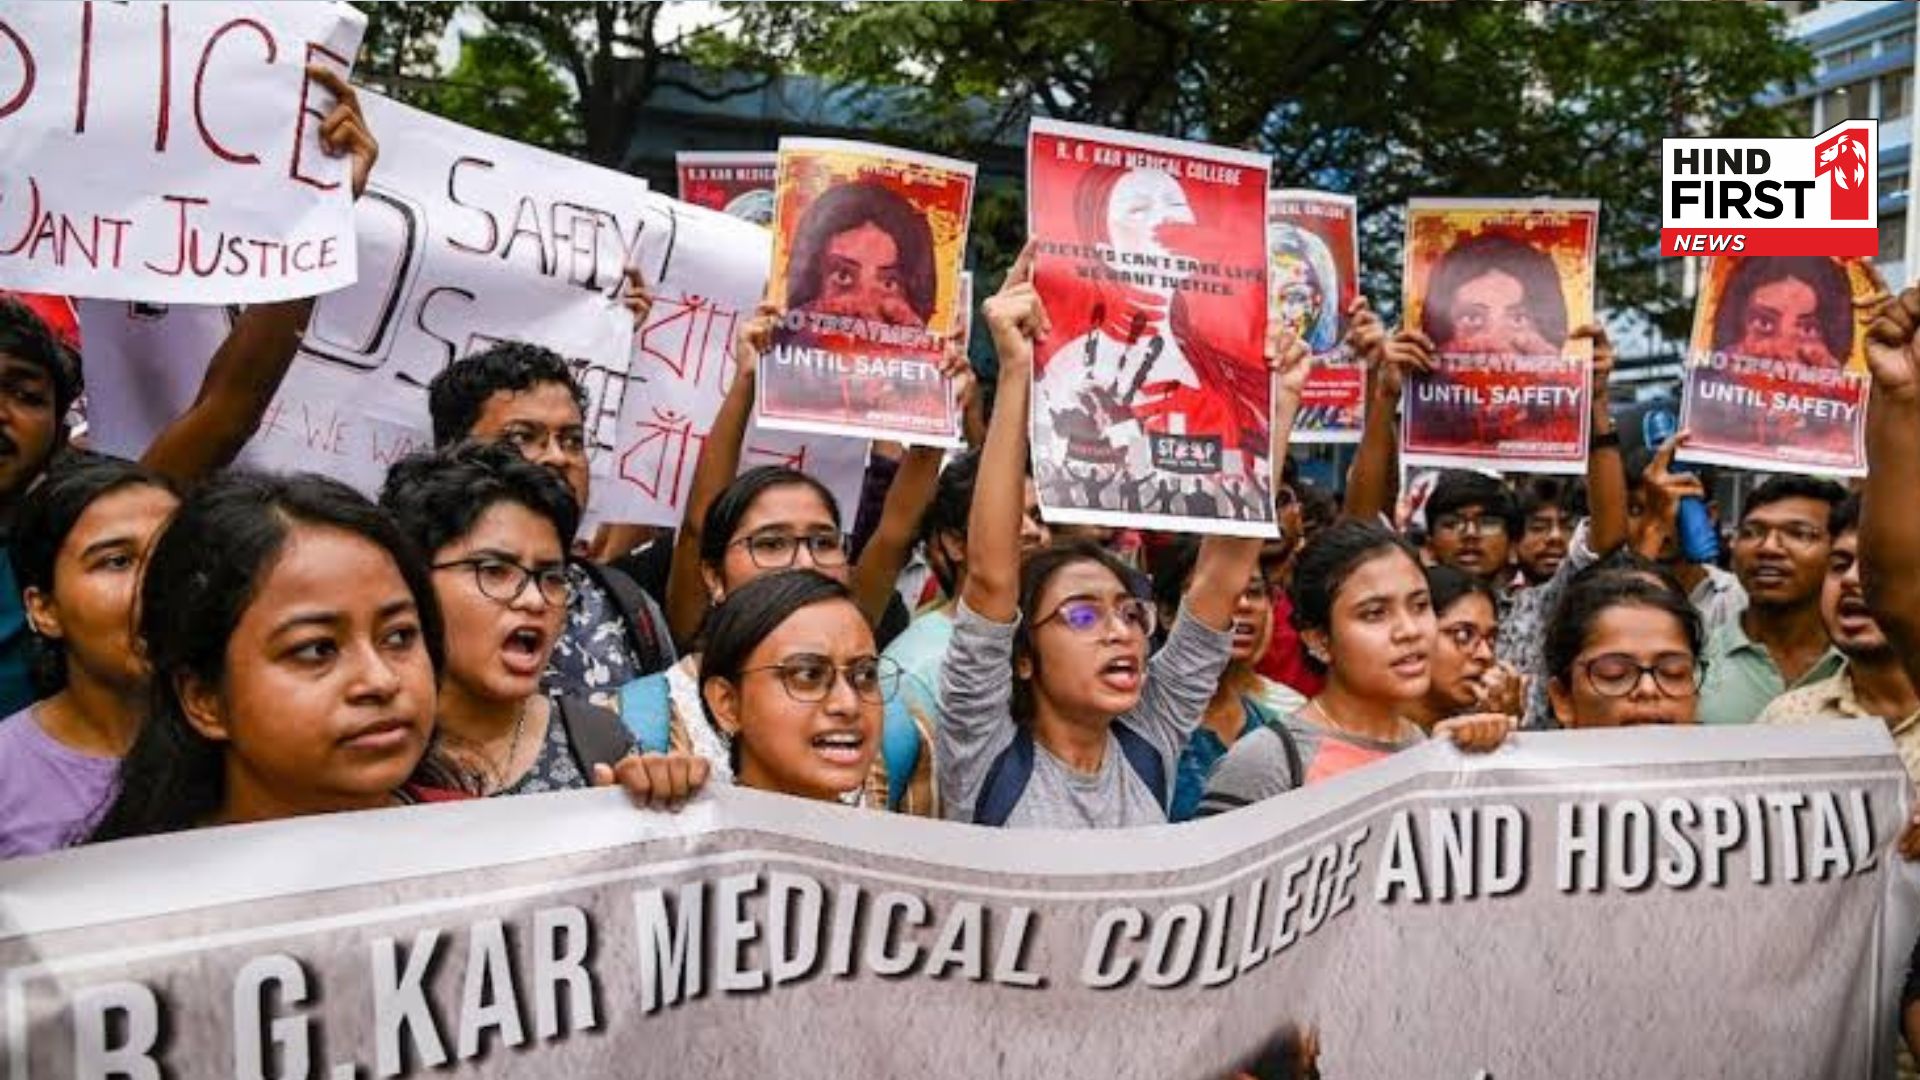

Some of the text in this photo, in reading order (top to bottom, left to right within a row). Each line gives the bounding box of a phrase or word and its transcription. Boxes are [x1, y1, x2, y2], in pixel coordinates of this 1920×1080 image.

[1093, 148, 1121, 168] KAR
[1124, 151, 1182, 177] MEDICAL
[1187, 161, 1242, 186] COLLEGE
[144, 194, 338, 278] JUSTICE
[774, 345, 942, 382] UNTIL SAFETY
[1419, 383, 1582, 408] UNTIL SAFETY
[1700, 381, 1857, 423] UNTIL SAFETY
[632, 870, 1046, 1014] MEDICAL
[1083, 825, 1368, 988] COLLEGE
[1376, 805, 1526, 903] AND
[1557, 788, 1878, 894] HOSPITAL
